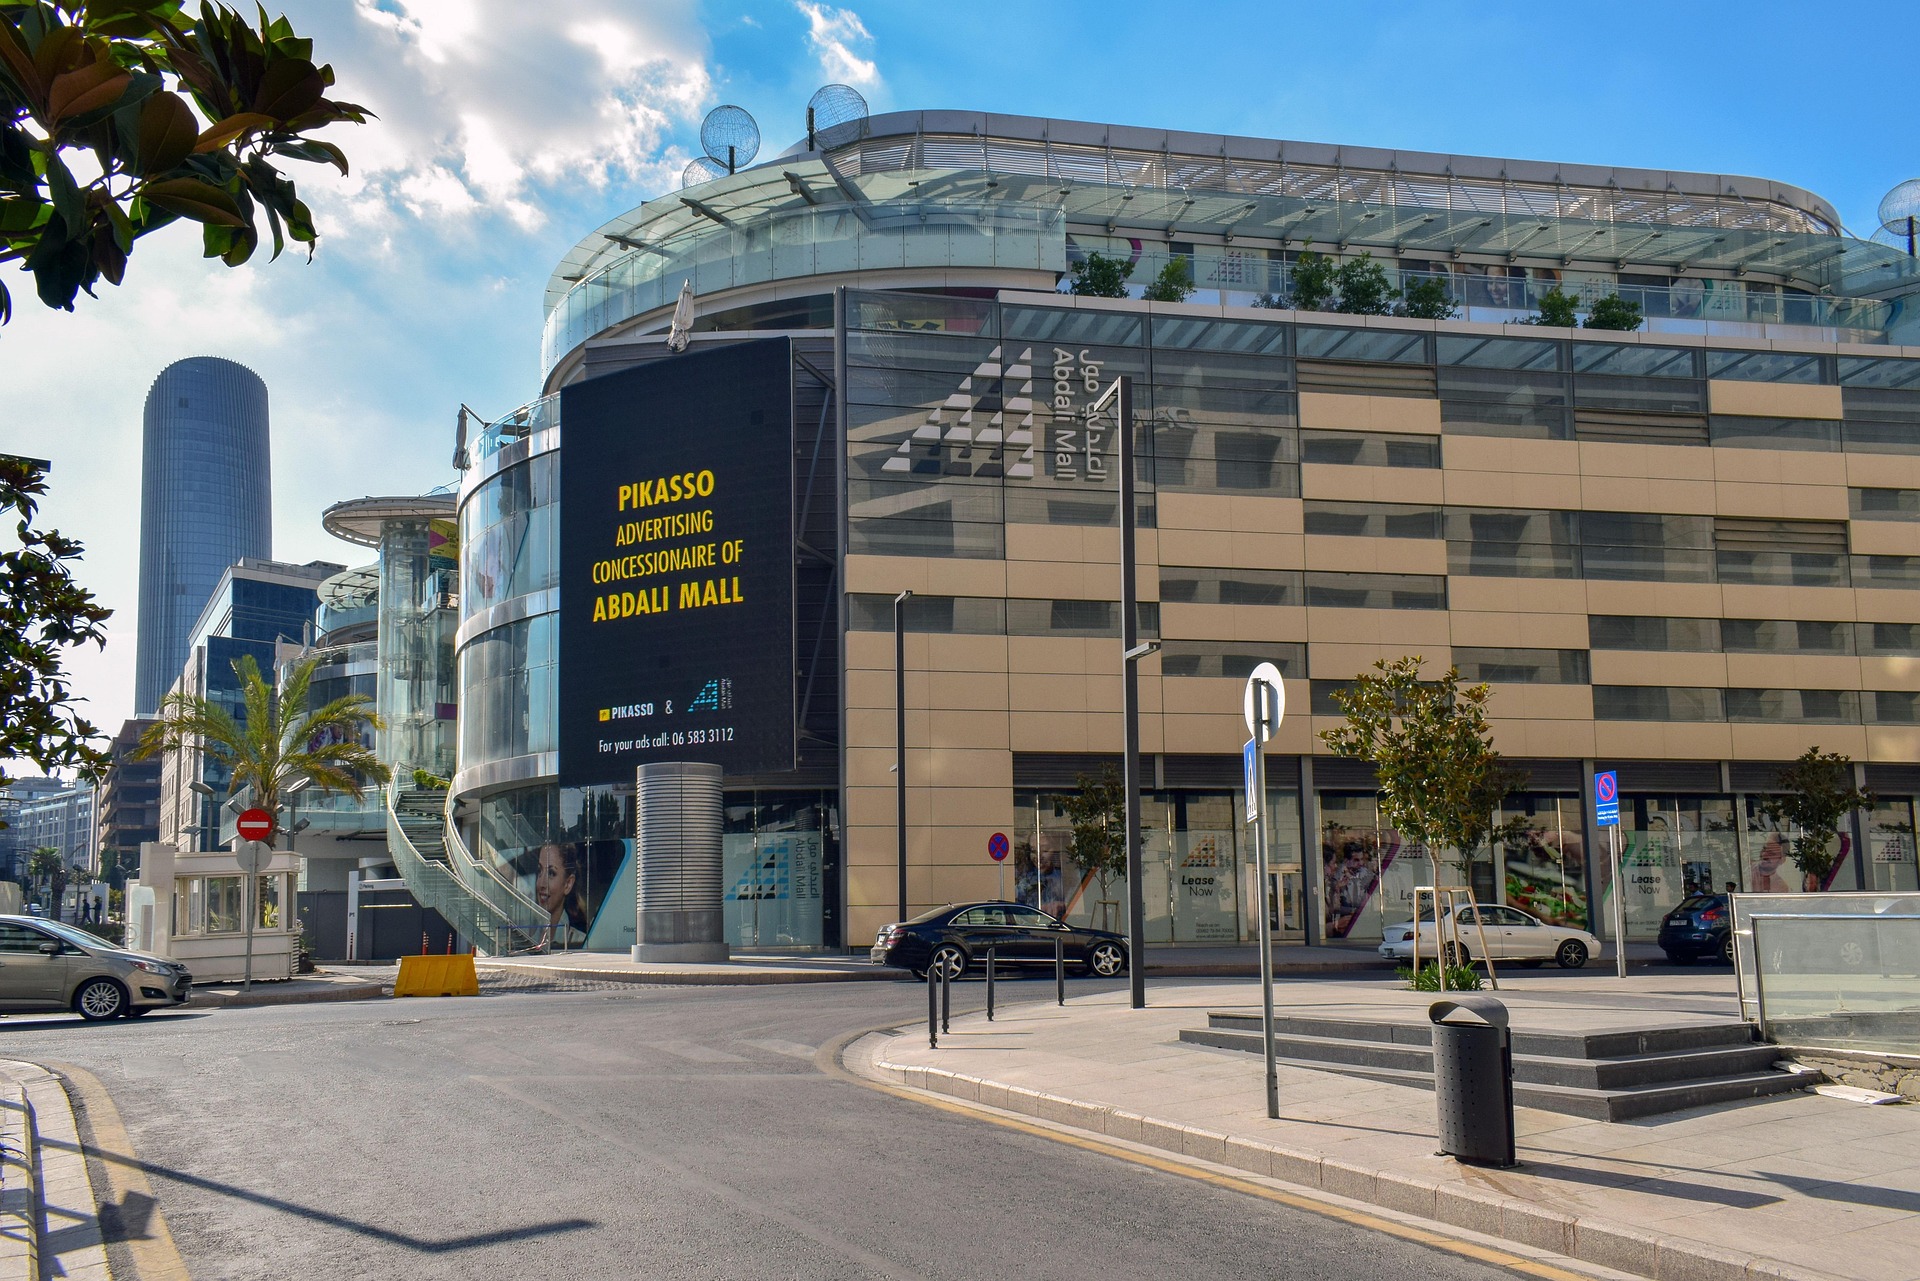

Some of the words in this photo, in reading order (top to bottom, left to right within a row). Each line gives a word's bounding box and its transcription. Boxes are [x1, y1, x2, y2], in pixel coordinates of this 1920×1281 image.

[1053, 347, 1076, 422] Abdali
[1079, 349, 1104, 393] مول
[1055, 429, 1077, 480] Mall
[618, 470, 714, 511] PIKASSO
[616, 510, 713, 547] ADVERTISING
[592, 544, 716, 584] CONCESSIONAIRE
[722, 540, 743, 564] OF
[592, 586, 669, 622] ABDALI
[679, 576, 744, 609] MALL
[611, 703, 654, 720] PIKASSO
[665, 700, 673, 715] &
[599, 740, 612, 753] For
[615, 740, 633, 754] your
[635, 735, 650, 749] ads
[652, 732, 670, 748] call:
[672, 731, 684, 746] 06
[687, 730, 706, 745] 583
[708, 728, 734, 743] 3112
[796, 839, 805, 872] Abdali
[796, 875, 806, 899] Mall
[1181, 875, 1215, 885] Lease
[1189, 886, 1213, 896] Now
[1631, 874, 1661, 884] Lease
[1638, 884, 1661, 894] Now
[1400, 890, 1434, 900] Lese
